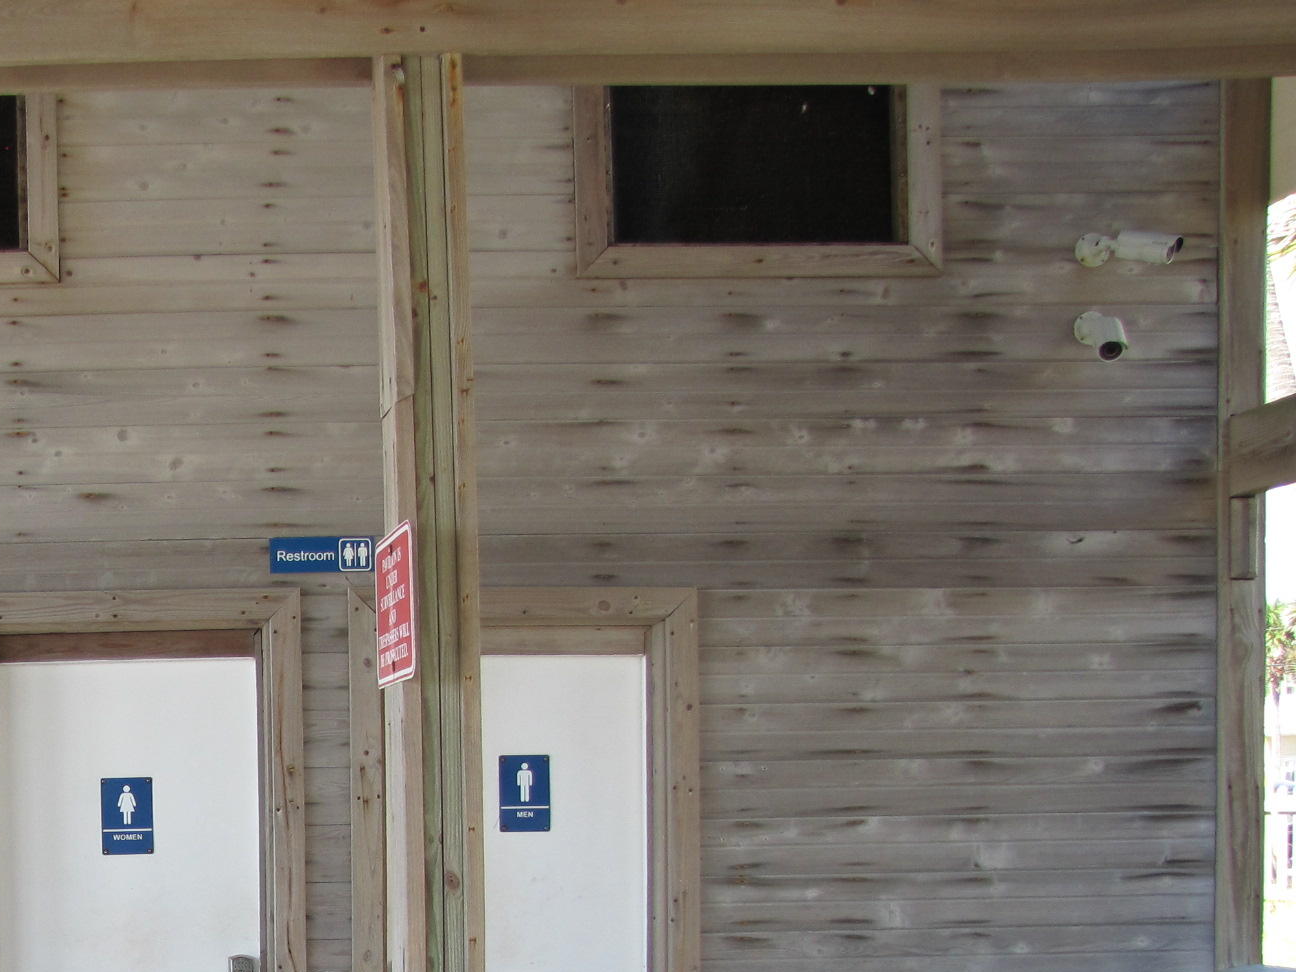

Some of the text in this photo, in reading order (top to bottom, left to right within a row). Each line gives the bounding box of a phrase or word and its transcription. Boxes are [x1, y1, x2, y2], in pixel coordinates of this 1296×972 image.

[277, 550, 335, 562] Restroom
[385, 569, 398, 590] UNDER
[380, 583, 406, 613] SURVEILLANCE
[388, 608, 397, 626] AND
[399, 622, 410, 639] WILL
